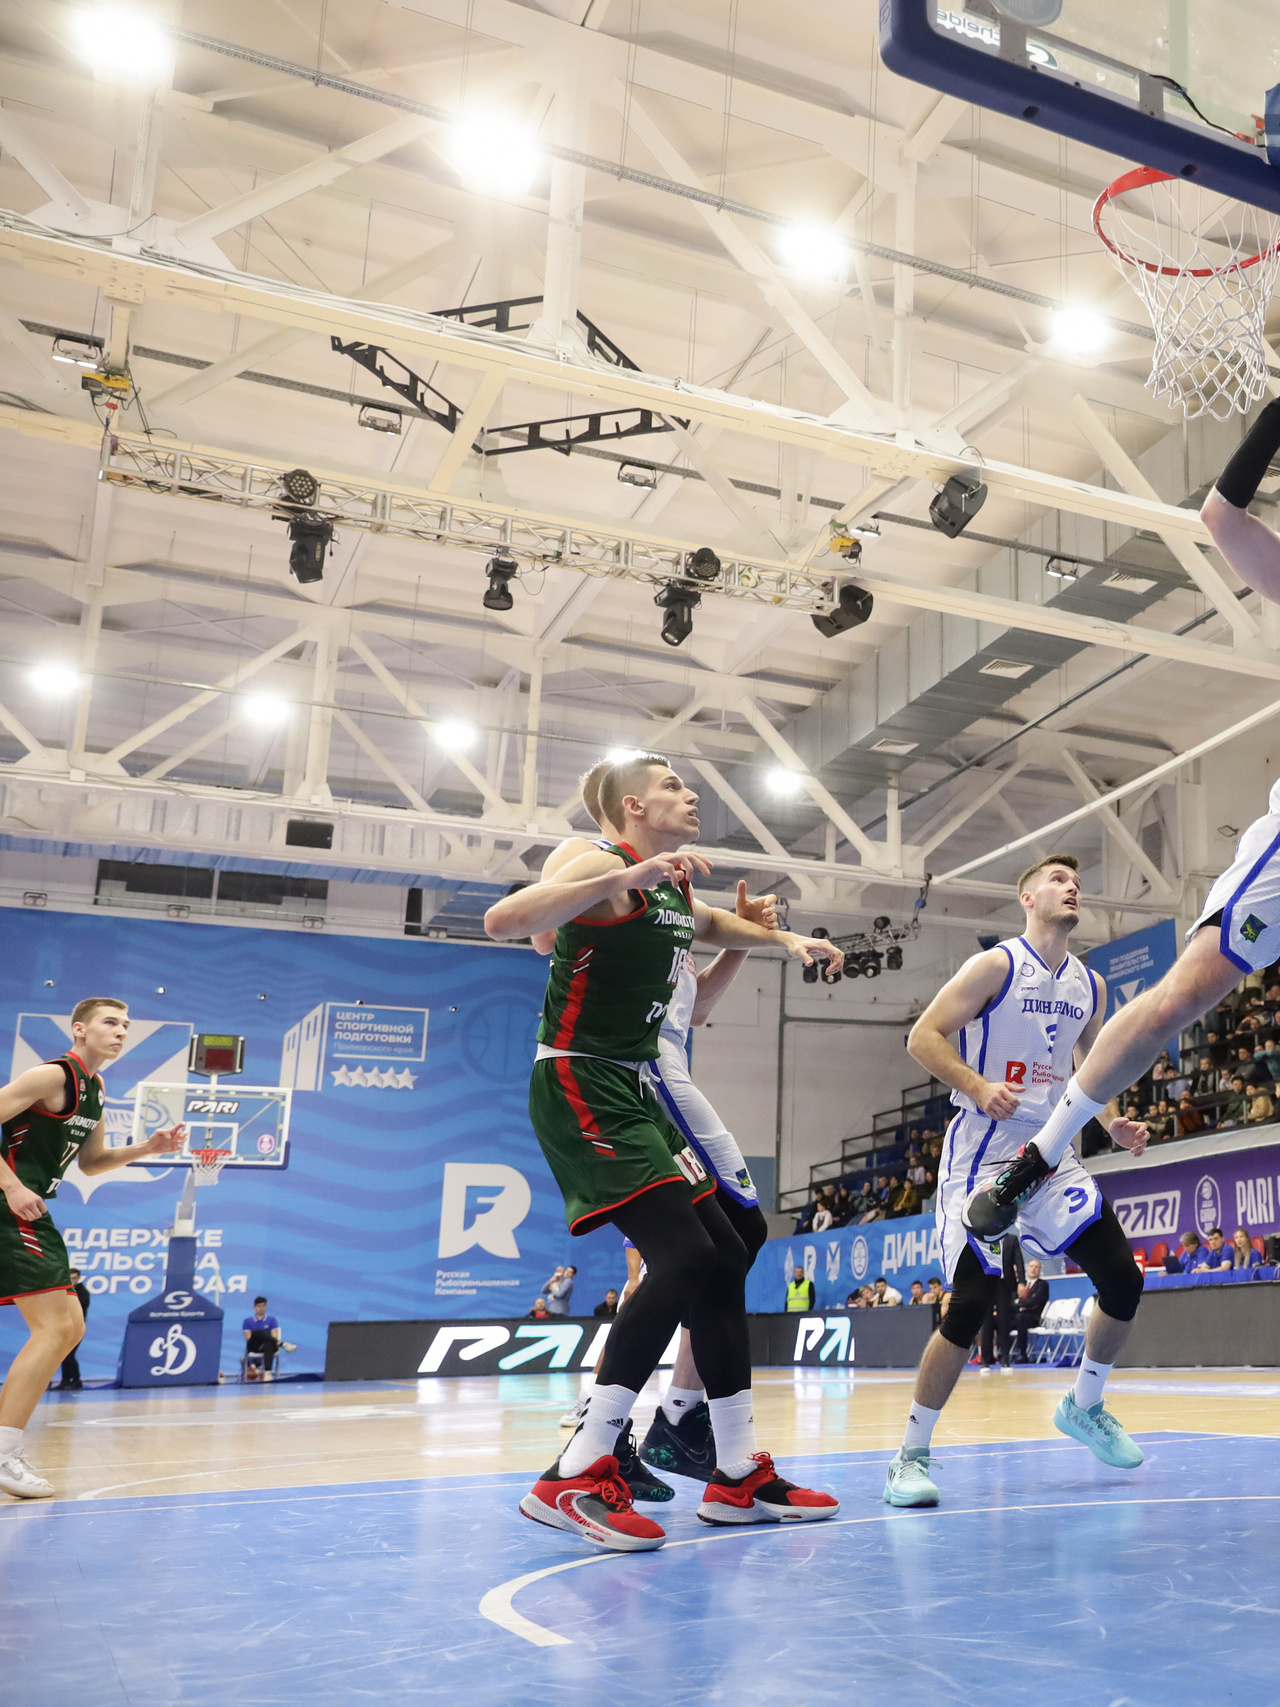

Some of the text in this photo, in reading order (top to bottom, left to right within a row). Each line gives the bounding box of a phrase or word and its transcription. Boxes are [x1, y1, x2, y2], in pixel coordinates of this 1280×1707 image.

[336, 1011, 375, 1021] ЦЕНТР
[1022, 999, 1084, 1020] ДИНАМО
[335, 1021, 414, 1034] СПОРТИВНОЙ
[334, 1031, 412, 1044] ПОДГОТОВКИ
[333, 1041, 392, 1053] Приморского
[1032, 1061, 1053, 1071] Русск
[187, 1100, 240, 1114] PARI
[60, 1141, 80, 1167] 17
[672, 1146, 708, 1186] 18
[1063, 1187, 1088, 1213] 3
[1235, 1176, 1275, 1226] PARI
[1116, 1196, 1177, 1232] PARI
[63, 1228, 223, 1250] ДДЕРЖЕ
[68, 1252, 220, 1271] ЕЛЬСТА
[436, 1270, 470, 1279] Русская
[160, 1275, 248, 1294] РАЯ
[435, 1279, 520, 1287] Рыбопромышленная
[435, 1288, 477, 1296] Компания
